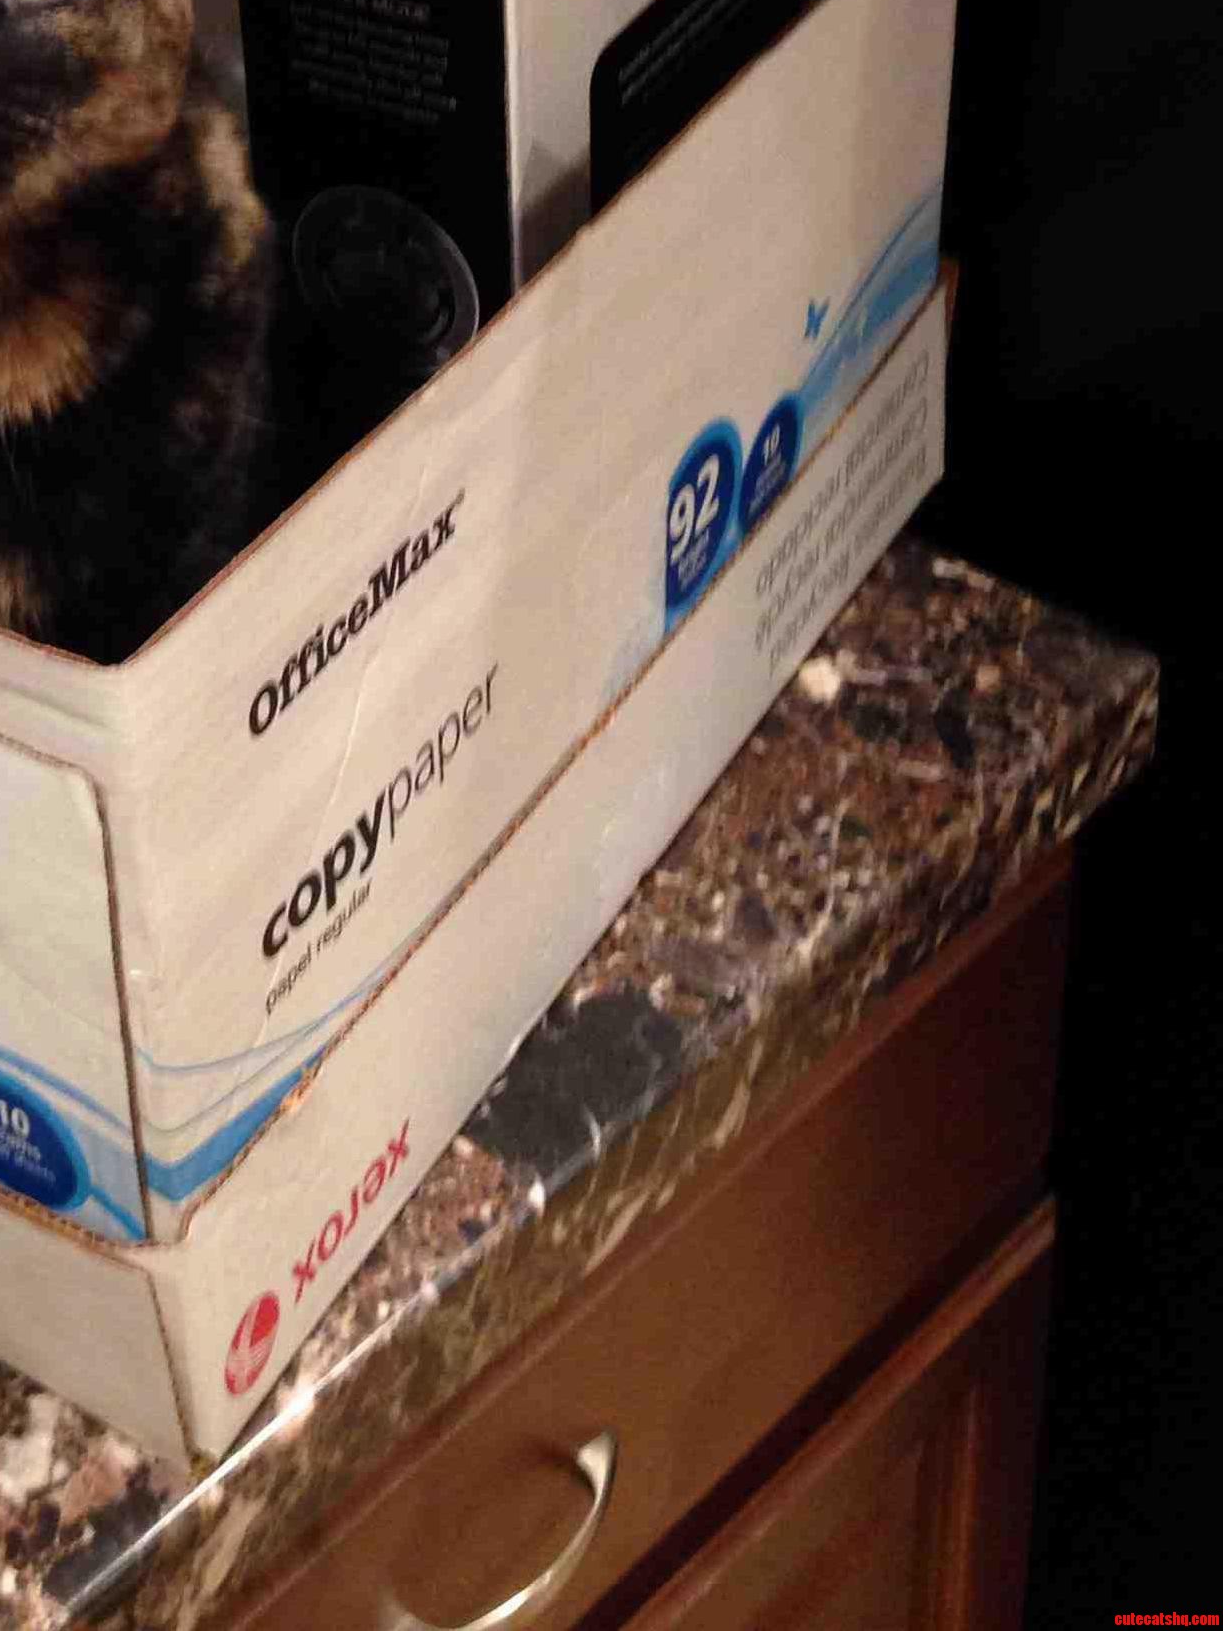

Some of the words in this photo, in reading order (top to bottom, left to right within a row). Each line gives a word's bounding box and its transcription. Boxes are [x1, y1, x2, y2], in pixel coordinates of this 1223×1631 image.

[670, 454, 720, 559] 92
[248, 493, 461, 737] OfficeMax
[265, 949, 313, 1017] papel
[314, 879, 372, 959] regular
